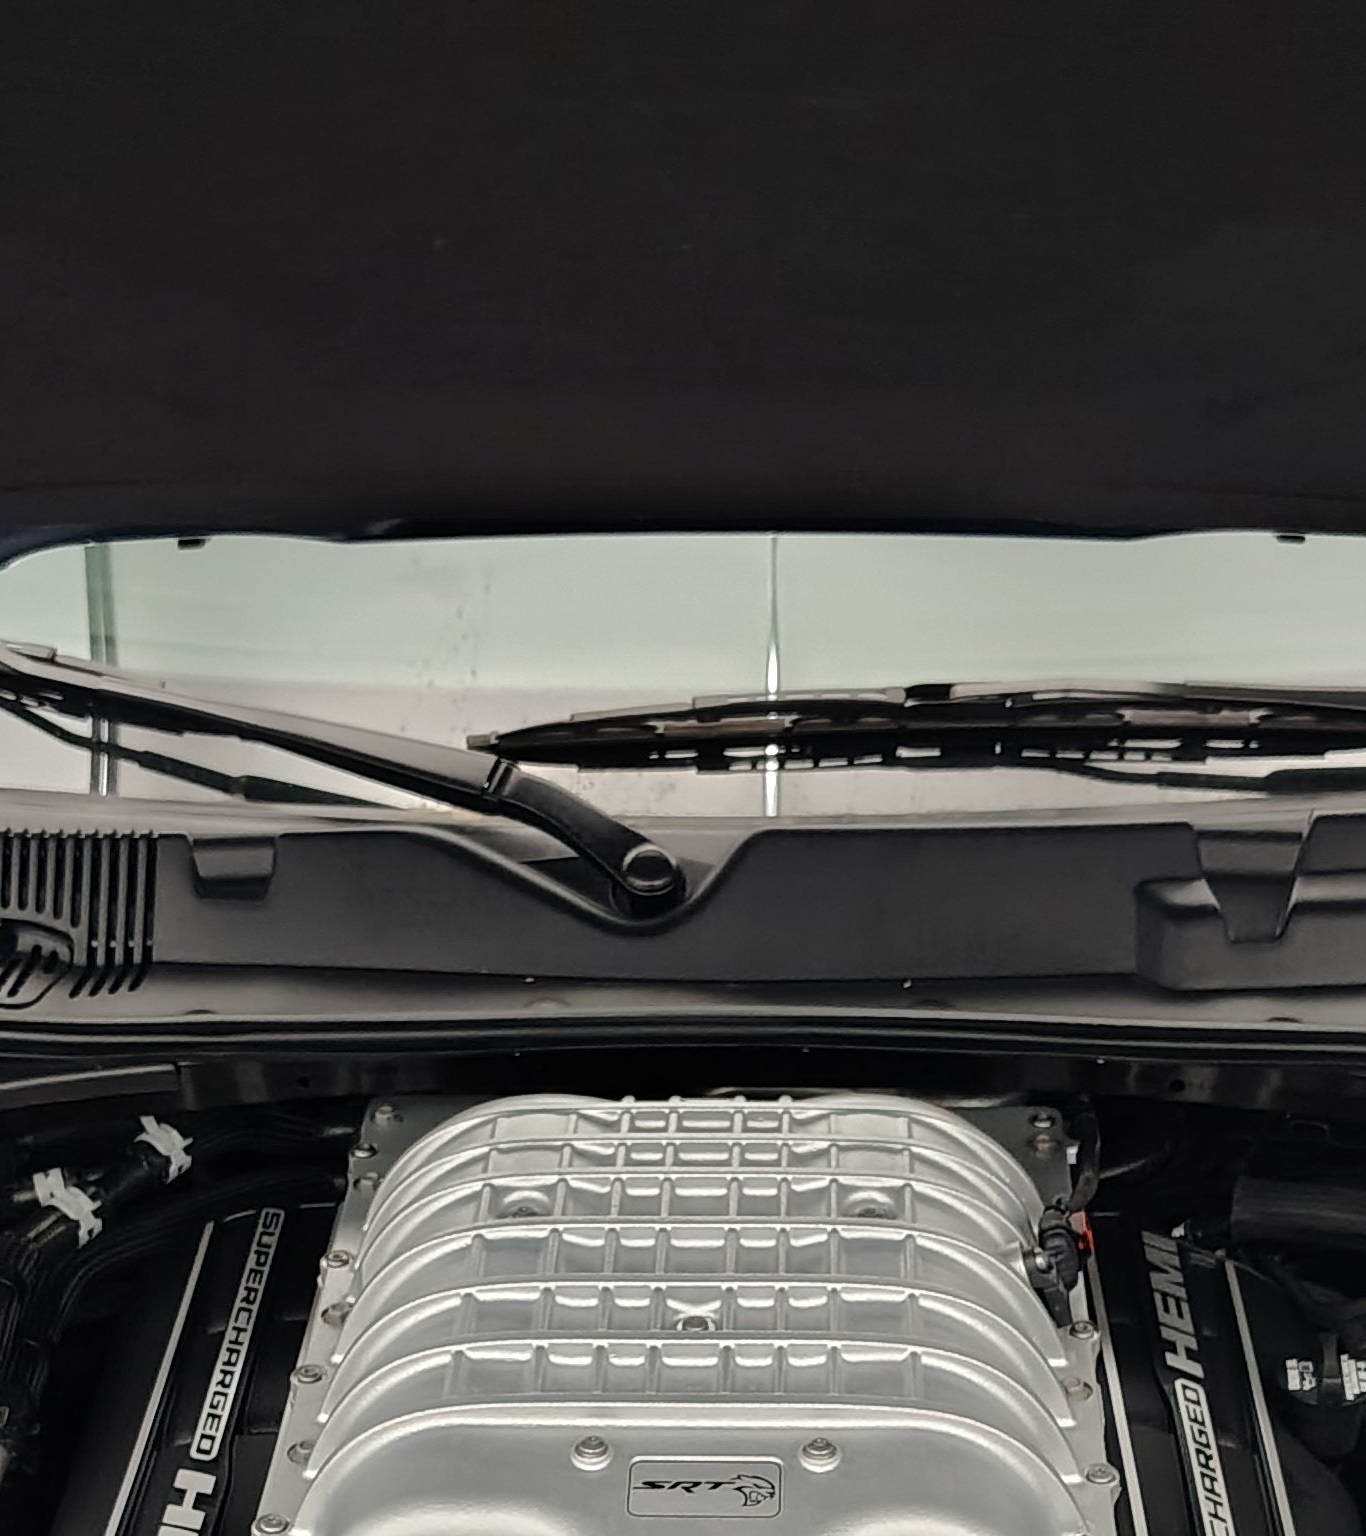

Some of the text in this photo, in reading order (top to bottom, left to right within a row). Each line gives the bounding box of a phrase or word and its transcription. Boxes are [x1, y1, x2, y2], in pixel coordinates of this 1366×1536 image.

[192, 1209, 284, 1458] SUPERCHARGED
[1141, 1230, 1204, 1379] HEMI
[633, 1480, 736, 1494] SRT
